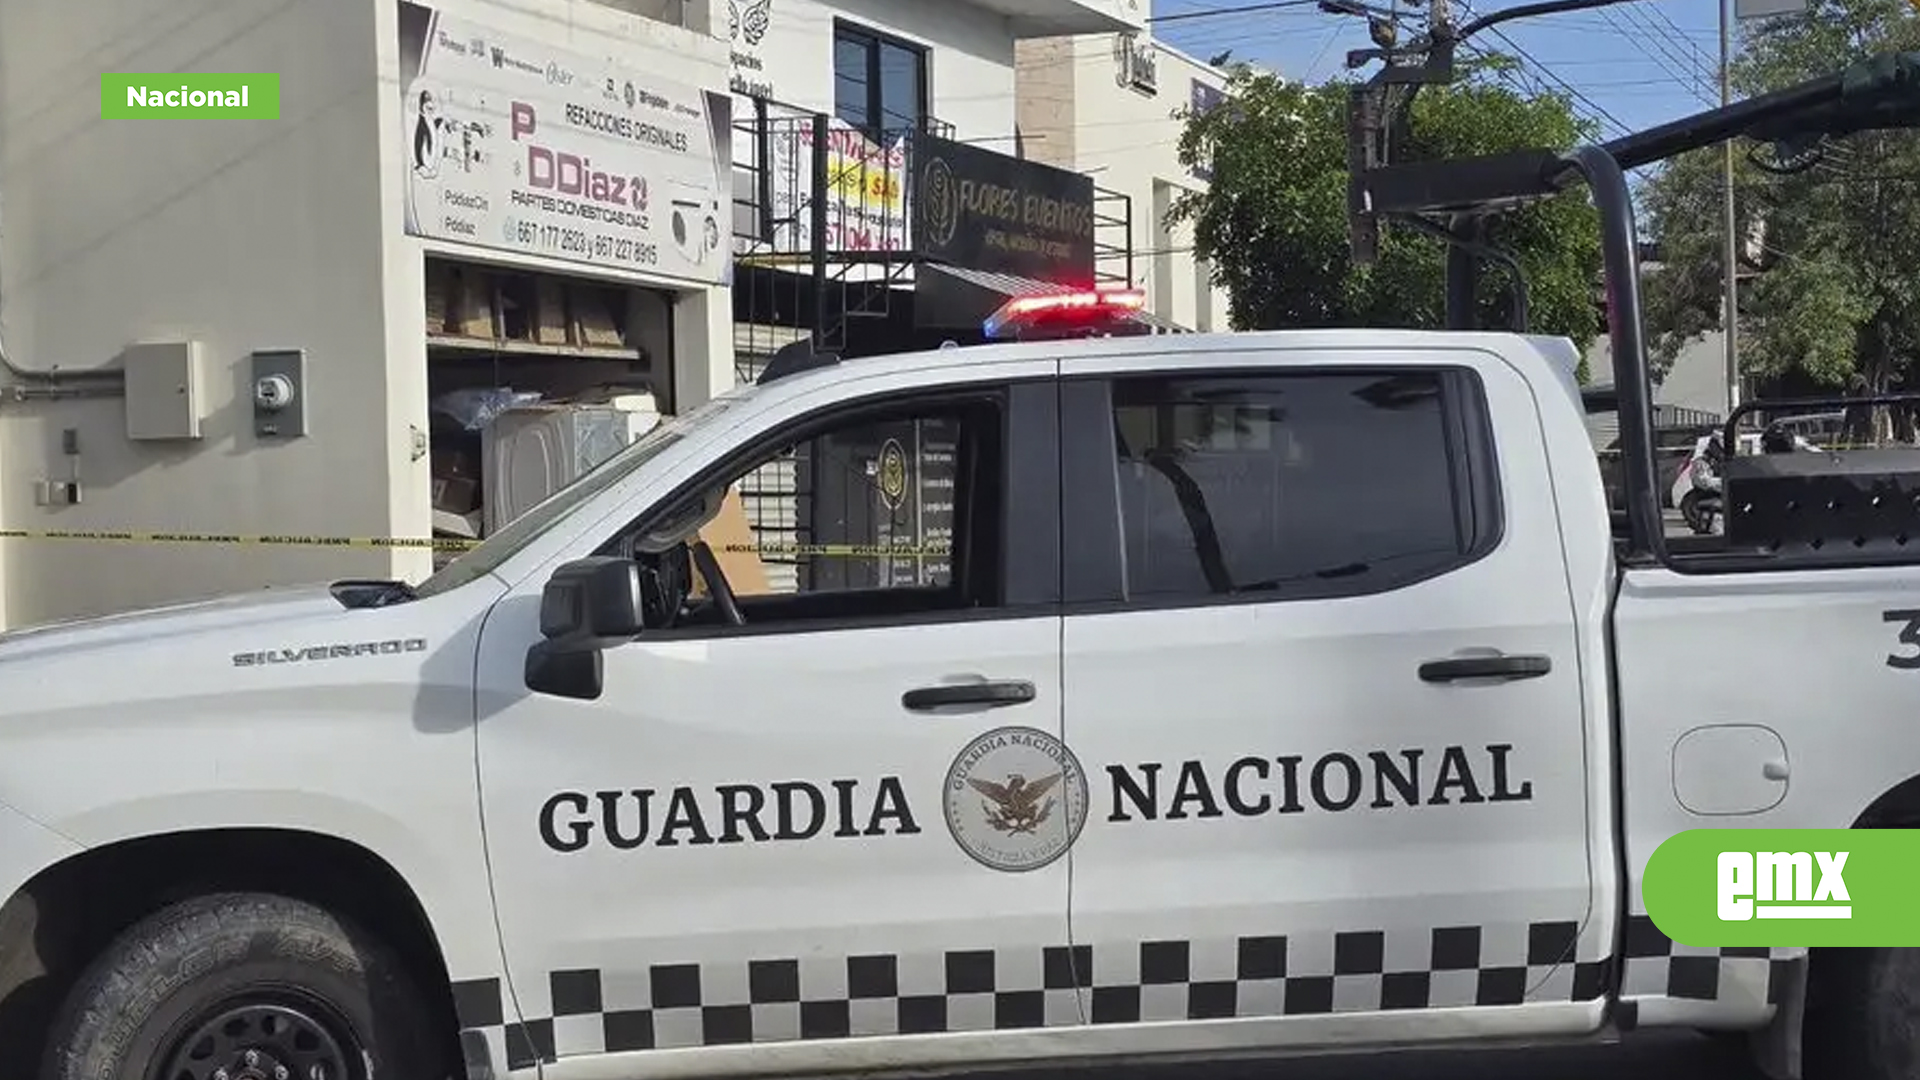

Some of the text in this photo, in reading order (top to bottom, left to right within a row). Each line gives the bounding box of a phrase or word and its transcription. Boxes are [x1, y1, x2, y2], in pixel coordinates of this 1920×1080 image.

[510, 101, 537, 141] P
[565, 102, 689, 152] REFACCIONES ORIGINALES
[528, 145, 628, 206] DDiaz
[511, 189, 650, 230] PARTES DOMESTICAS DIAZ
[959, 179, 1019, 221] FLORES
[518, 220, 537, 244] 667
[540, 225, 560, 249] 177
[595, 234, 614, 258] 667
[232, 637, 428, 668] SILVERADO
[1882, 609, 1920, 670] 3
[953, 734, 1078, 791] GUARDIA NACIONAL
[538, 744, 1533, 853] GUARDIA NACIONAL
